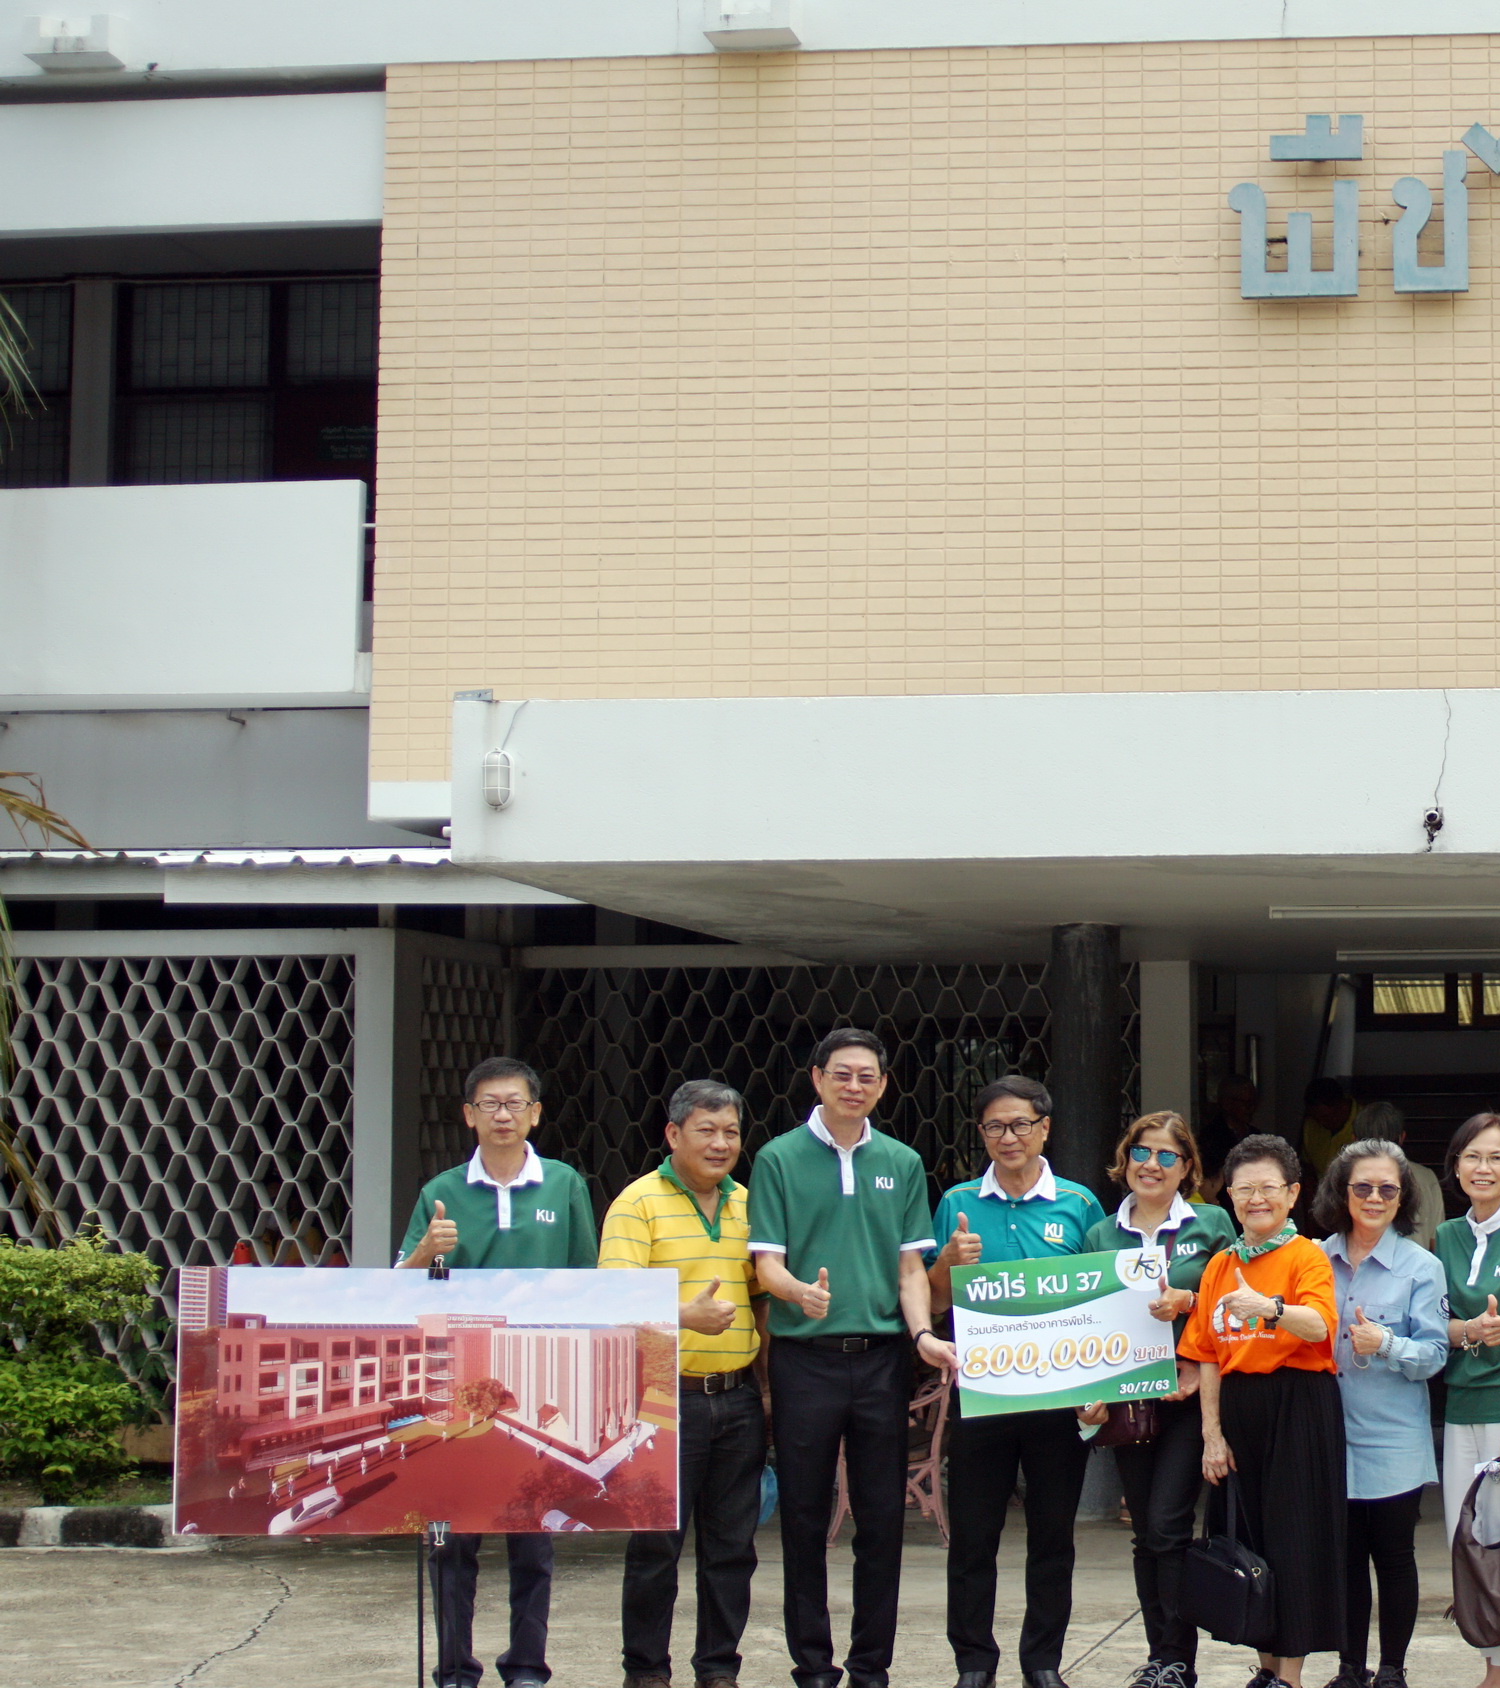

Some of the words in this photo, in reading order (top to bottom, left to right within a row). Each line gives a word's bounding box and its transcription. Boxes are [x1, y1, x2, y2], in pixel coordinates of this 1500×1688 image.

[875, 1175, 894, 1189] KU
[536, 1208, 555, 1223] KU
[1044, 1222, 1064, 1239] KU
[1176, 1242, 1198, 1256] KU
[965, 1271, 1027, 1302] พืชไร่
[1037, 1274, 1069, 1296] KU
[1075, 1270, 1103, 1292] 37
[963, 1331, 1130, 1379] 800,000
[1134, 1344, 1169, 1361] บาท
[1119, 1379, 1170, 1394] 30/7/63
